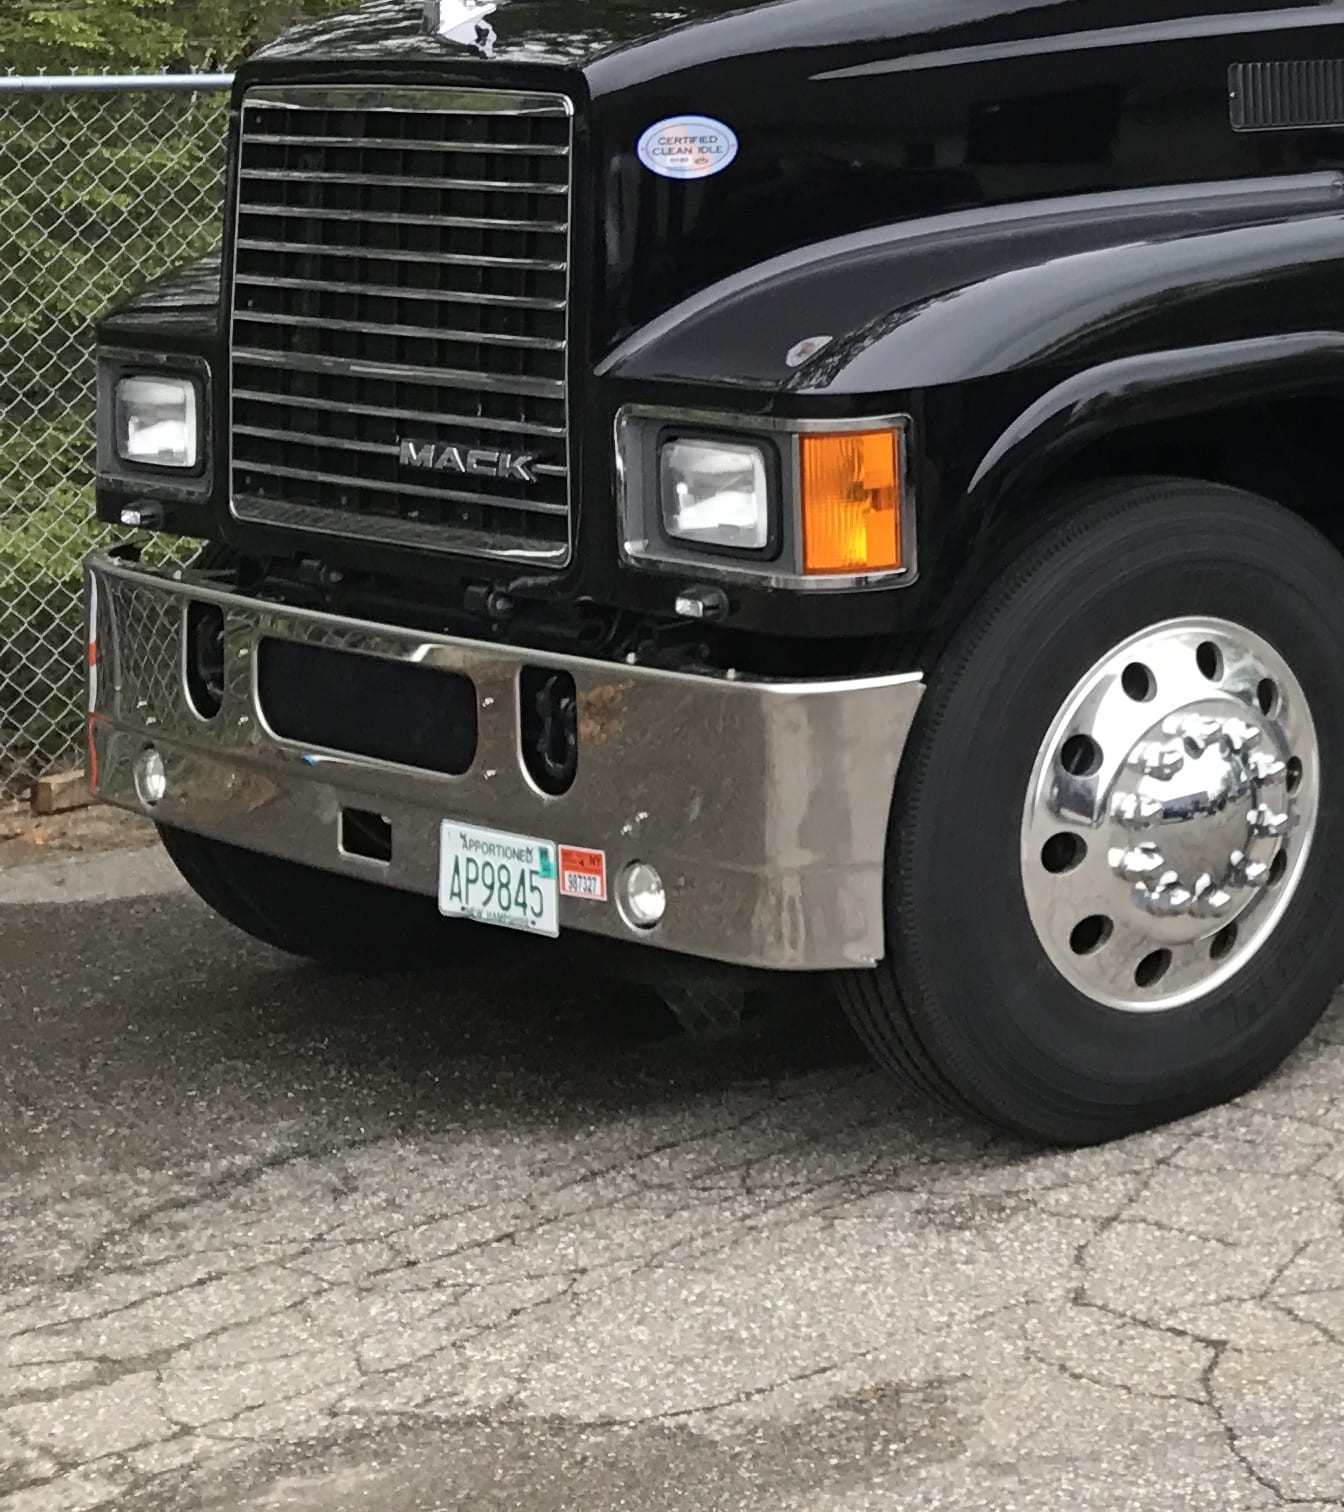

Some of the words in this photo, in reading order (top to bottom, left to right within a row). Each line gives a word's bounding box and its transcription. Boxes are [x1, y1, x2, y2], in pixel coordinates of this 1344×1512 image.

[651, 146, 693, 156] CLEAN
[697, 145, 723, 154] IDLE
[657, 135, 718, 146] CERTIFIED
[399, 438, 538, 483] MACK
[461, 835, 534, 864] APPORTIONED
[449, 854, 544, 918] AP9845
